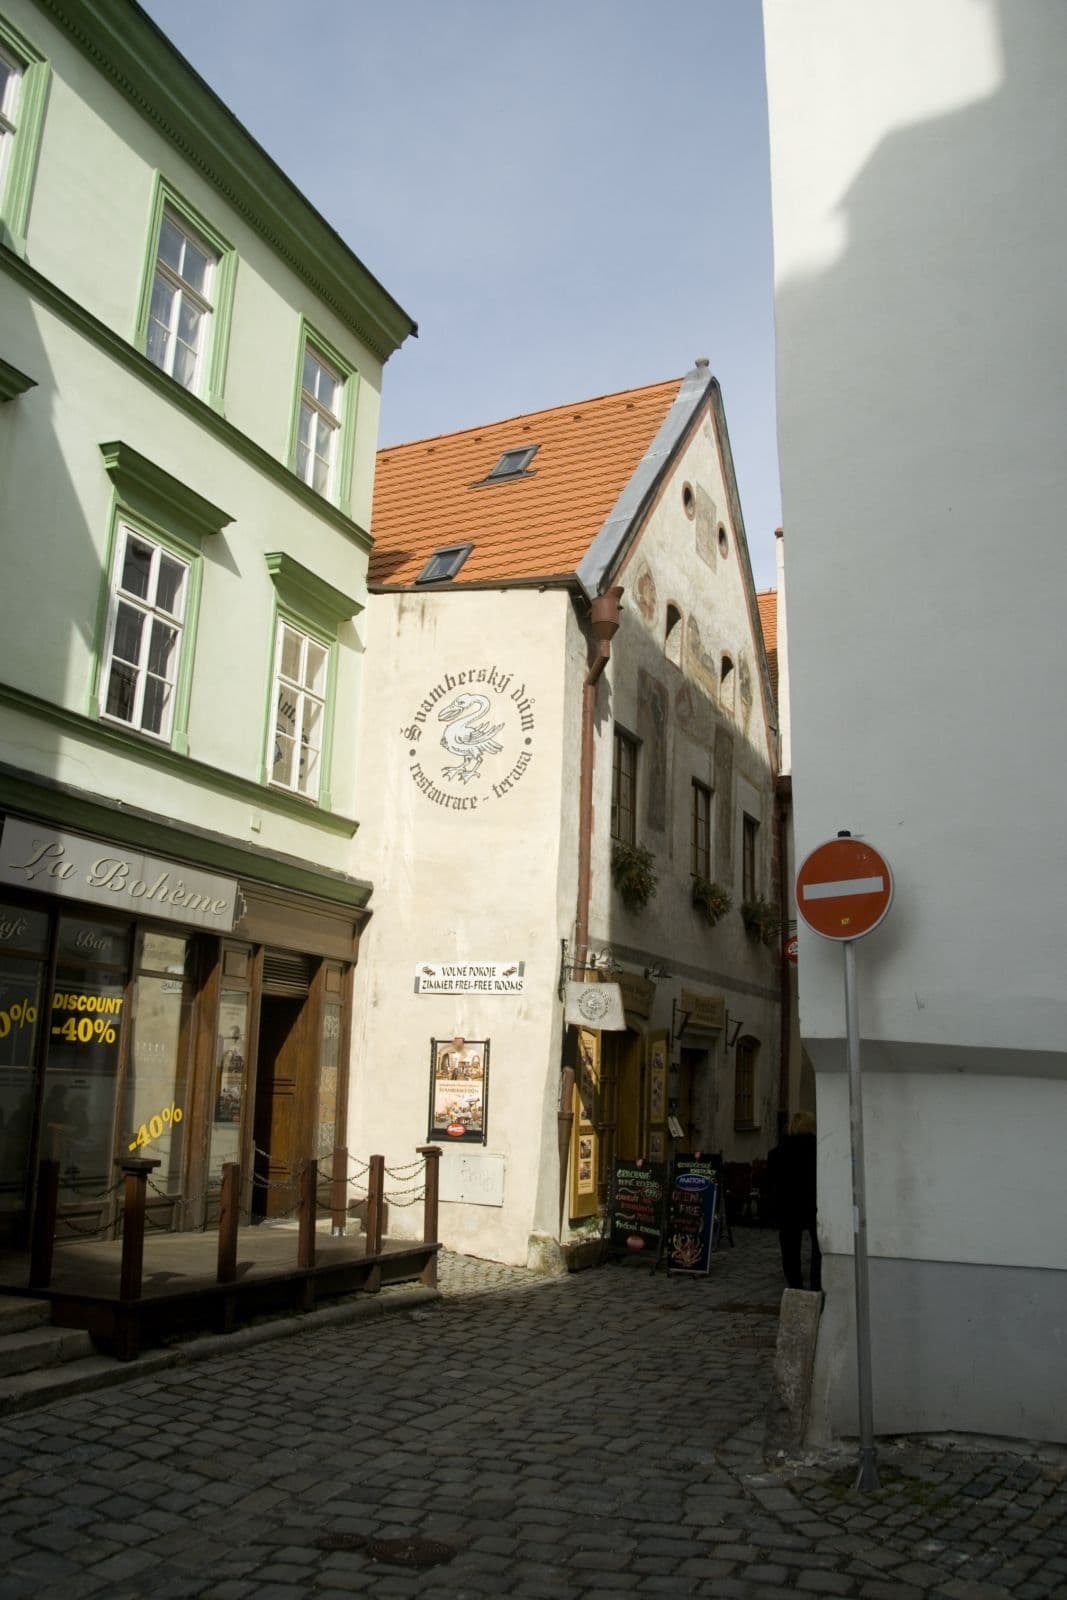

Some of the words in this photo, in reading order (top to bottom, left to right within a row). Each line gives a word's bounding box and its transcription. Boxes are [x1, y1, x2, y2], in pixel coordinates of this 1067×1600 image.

[510, 683, 536, 733] dům
[409, 762, 478, 811] restaurace
[491, 751, 533, 799] terasa
[7, 839, 79, 881] La
[421, 980, 454, 991] ZIMMER
[494, 980, 524, 991] ROOMS
[468, 966, 497, 978] POKOJE
[52, 993, 124, 1014] DISCOUNT
[51, 1017, 116, 1044] -40%
[128, 1100, 183, 1152] -40%
